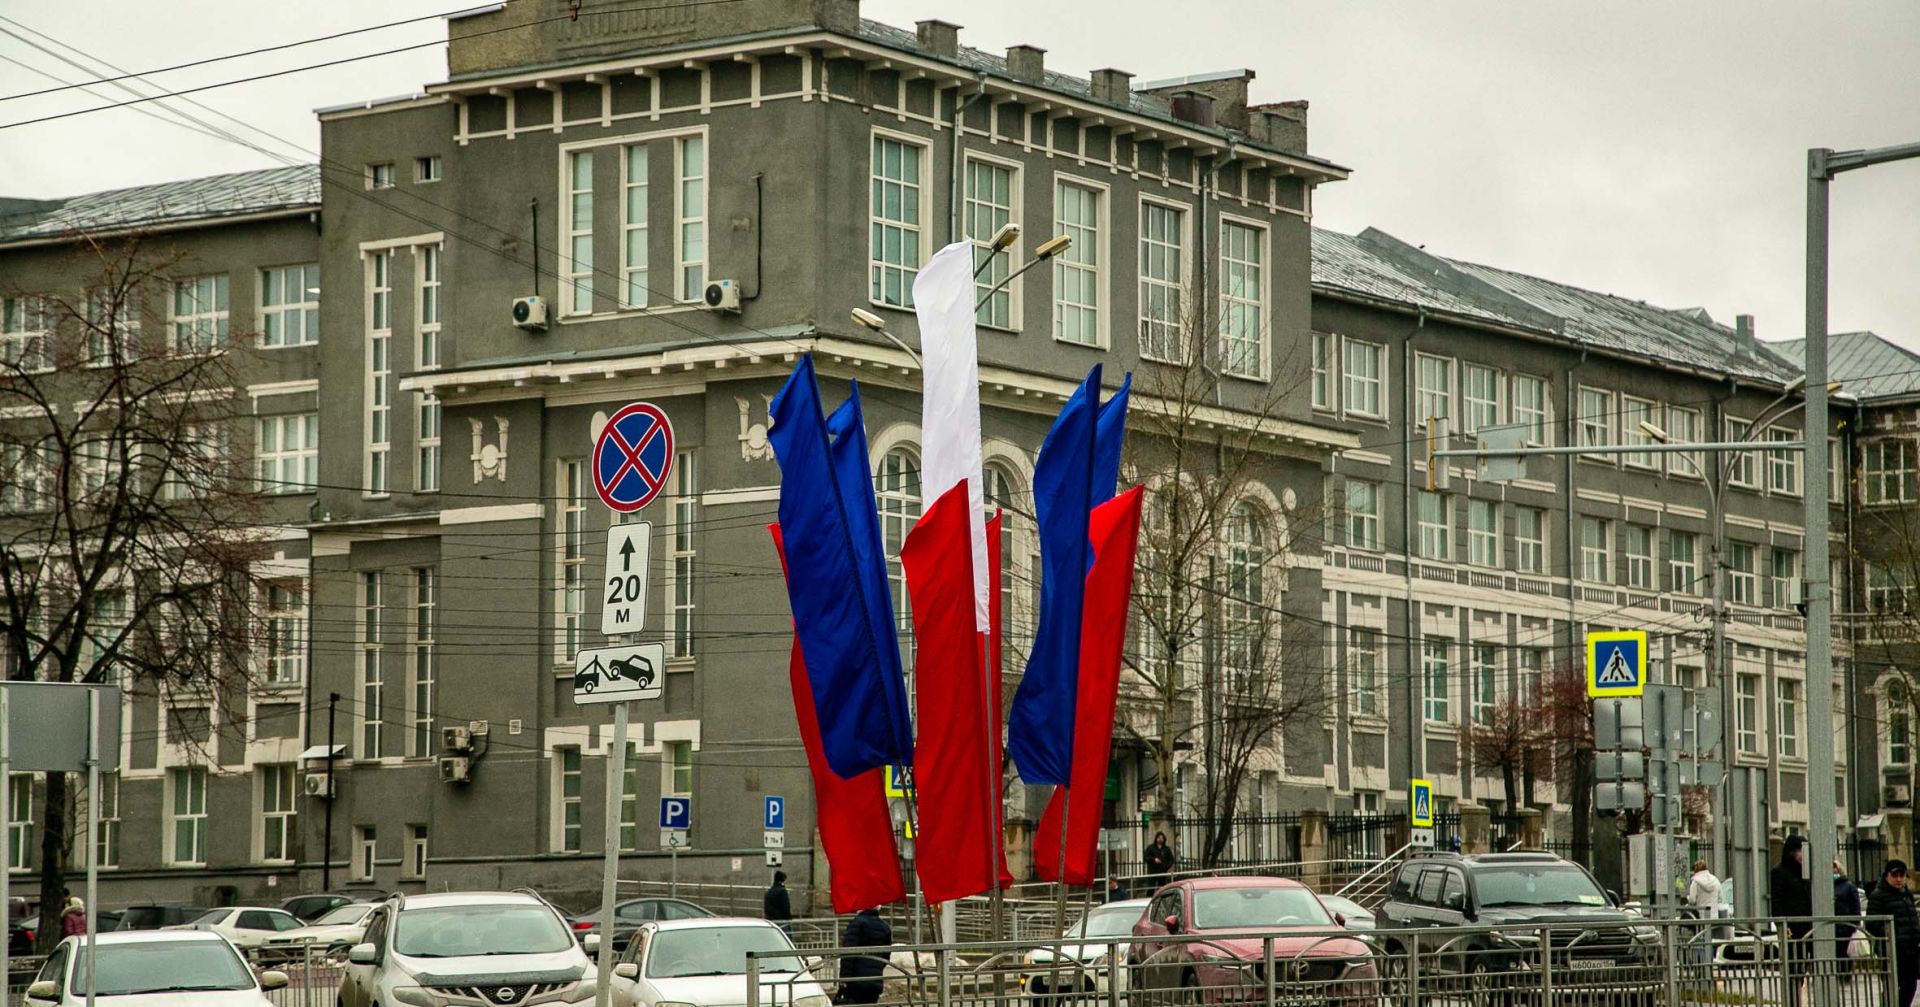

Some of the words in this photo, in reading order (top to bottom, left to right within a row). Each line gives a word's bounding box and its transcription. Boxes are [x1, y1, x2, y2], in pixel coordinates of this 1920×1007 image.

[607, 575, 641, 604] 20
[666, 800, 684, 825] P
[769, 800, 780, 824] P
